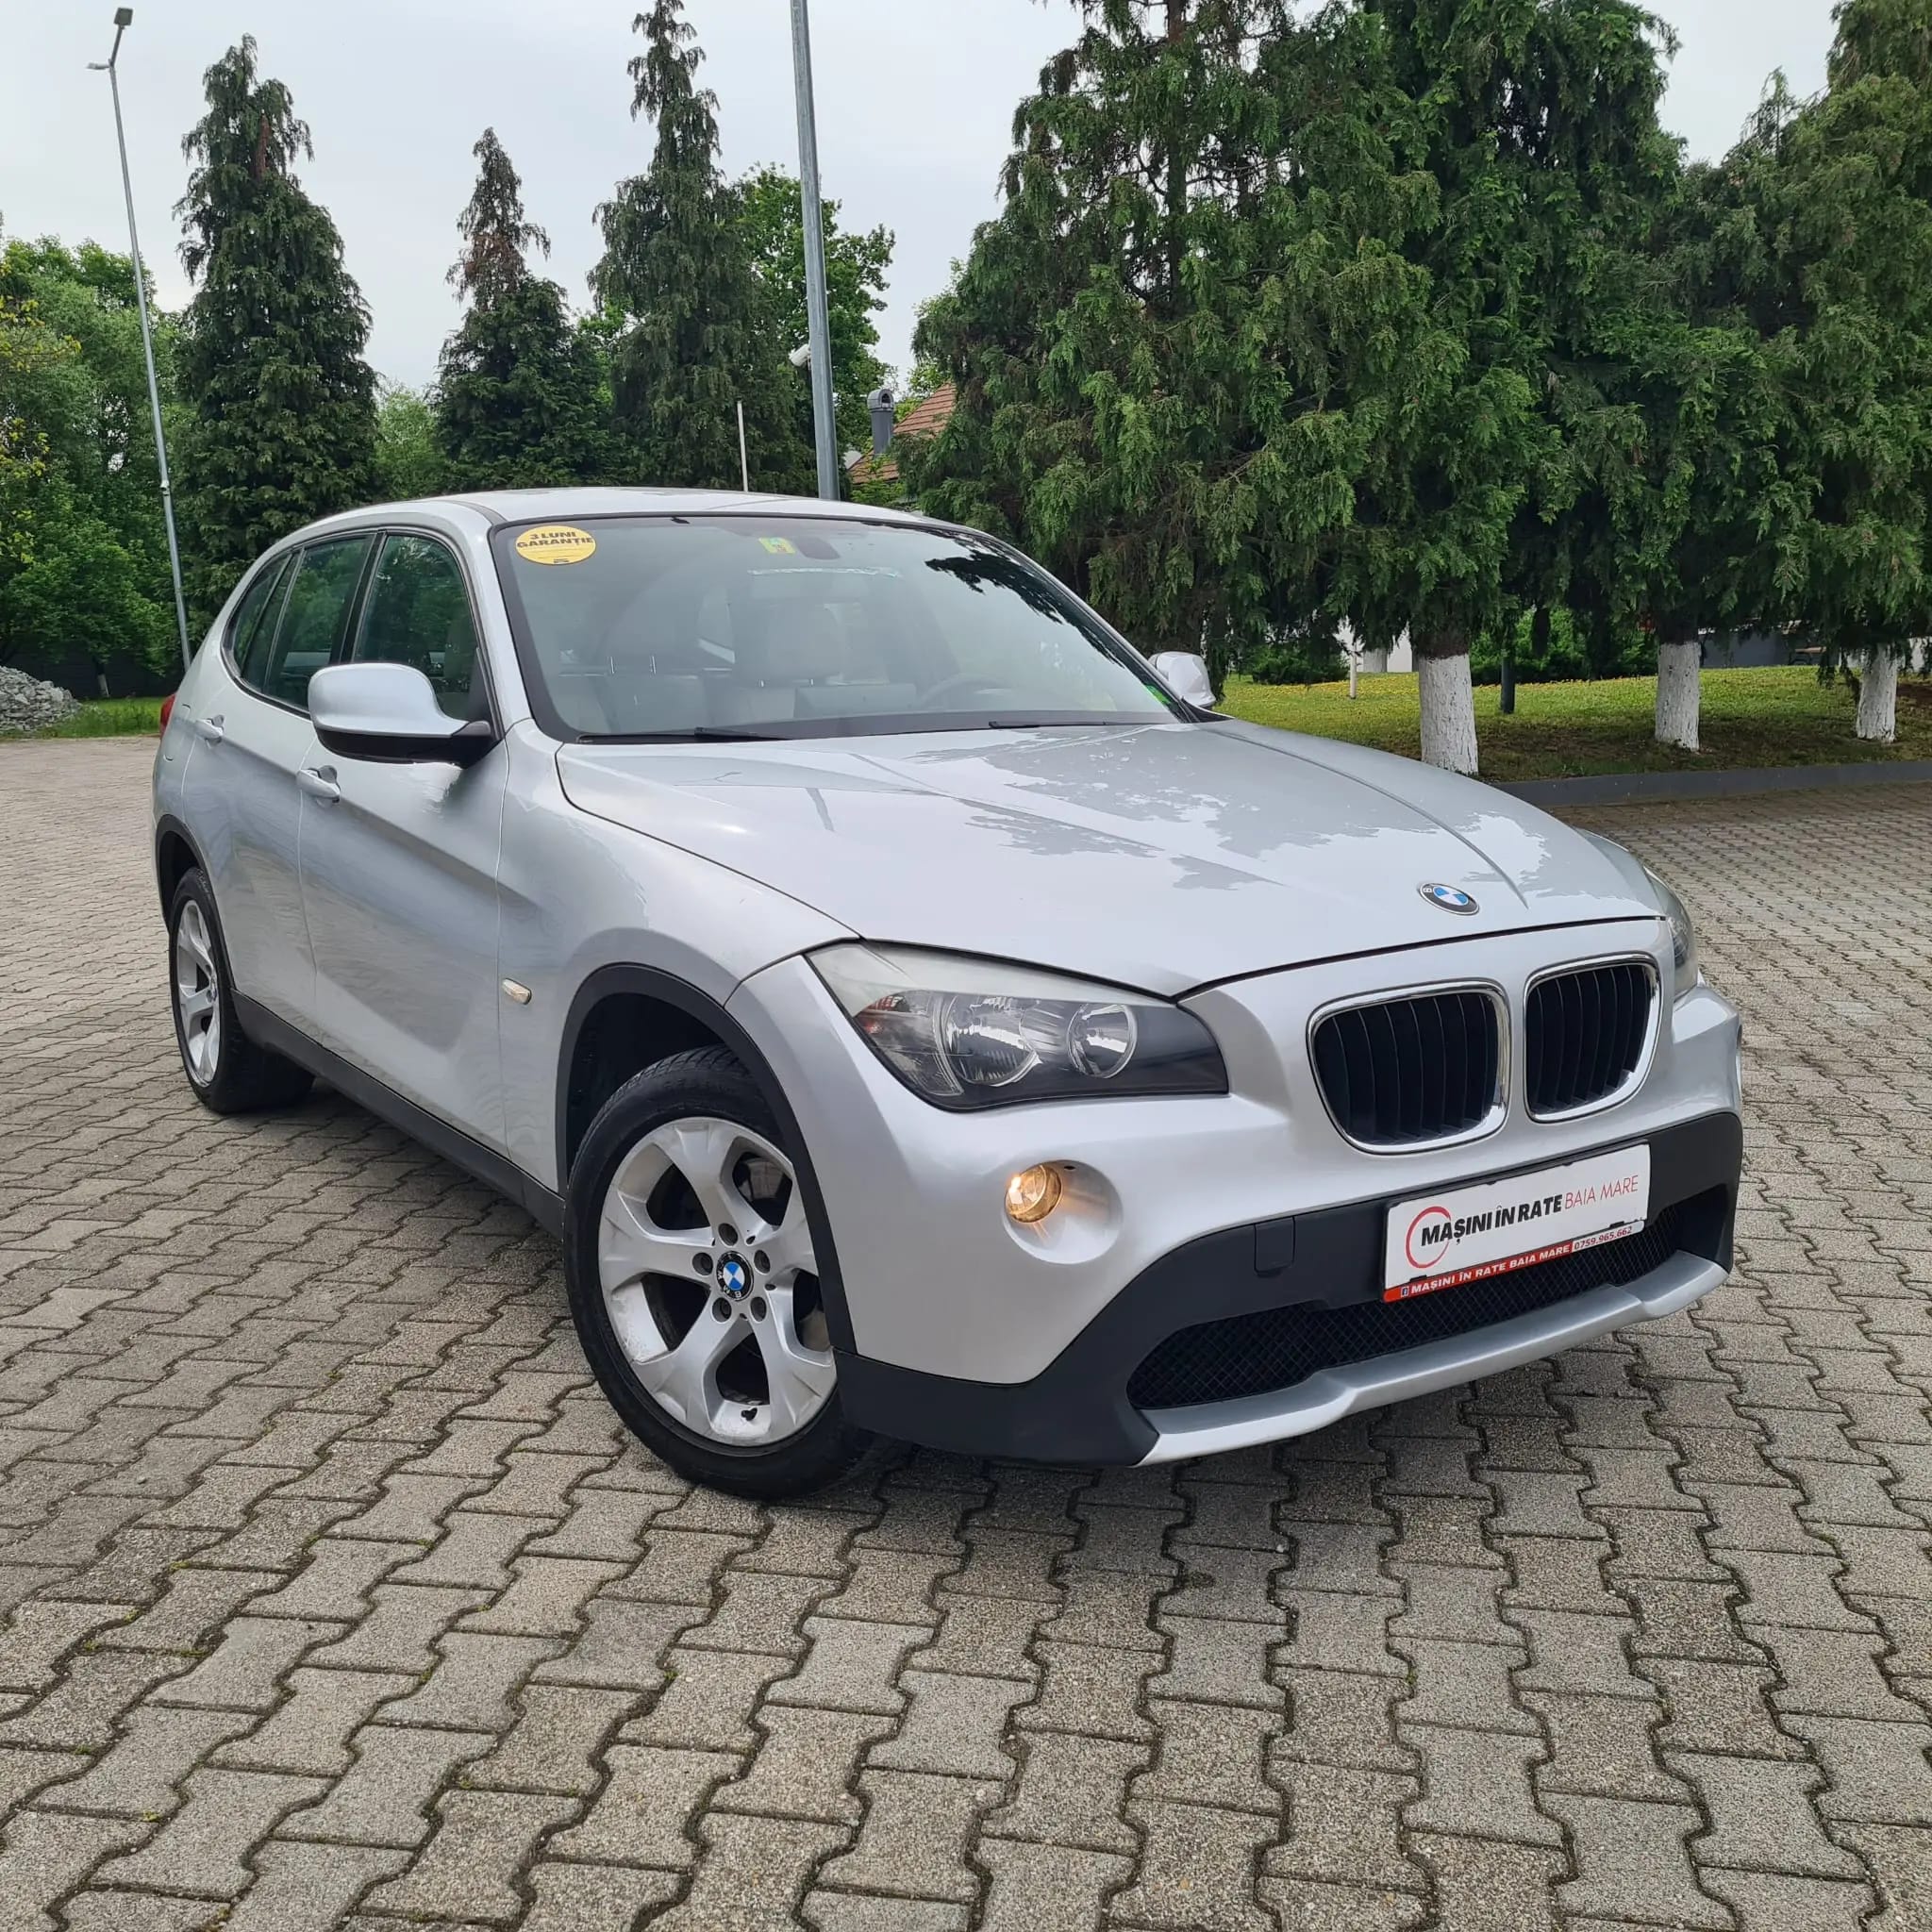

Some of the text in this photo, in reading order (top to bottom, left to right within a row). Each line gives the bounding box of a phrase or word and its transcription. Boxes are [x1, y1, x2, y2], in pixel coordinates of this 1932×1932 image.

[1421, 1174, 1639, 1246] MAȘINI ÎN RATE BAIA MARE
[1410, 1274, 1456, 1294] MAȘINI
[1474, 1262, 1507, 1278] RATE
[1508, 1254, 1537, 1269] BAIA
[1539, 1244, 1571, 1261] MARE
[1574, 1225, 1633, 1251] 0759.965.662
